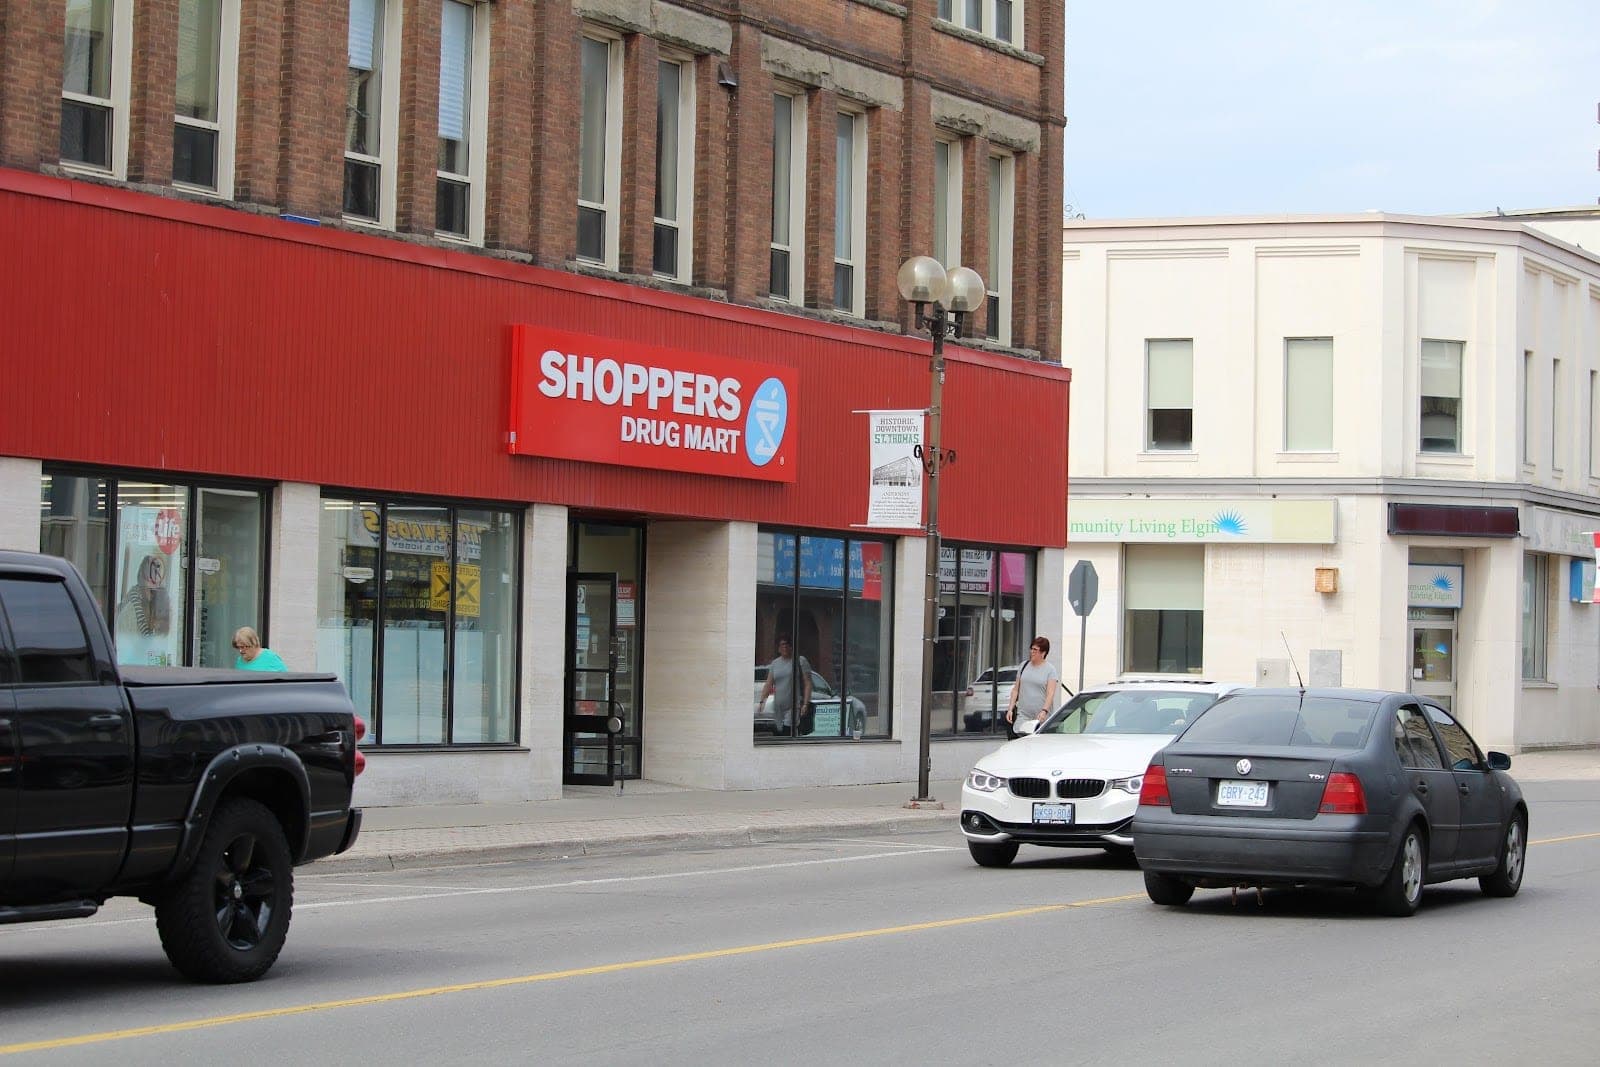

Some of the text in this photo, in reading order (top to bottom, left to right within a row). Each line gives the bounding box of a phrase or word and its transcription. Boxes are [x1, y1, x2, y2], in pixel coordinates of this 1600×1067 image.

[538, 350, 741, 421] SHOPPERS
[621, 416, 741, 454] DRUG MART
[875, 425, 919, 433] DOWNTOWN
[1129, 518, 1176, 537] Living
[1182, 518, 1220, 537] Elgin
[1411, 591, 1433, 601] Living
[1220, 785, 1266, 801] CBRY 243
